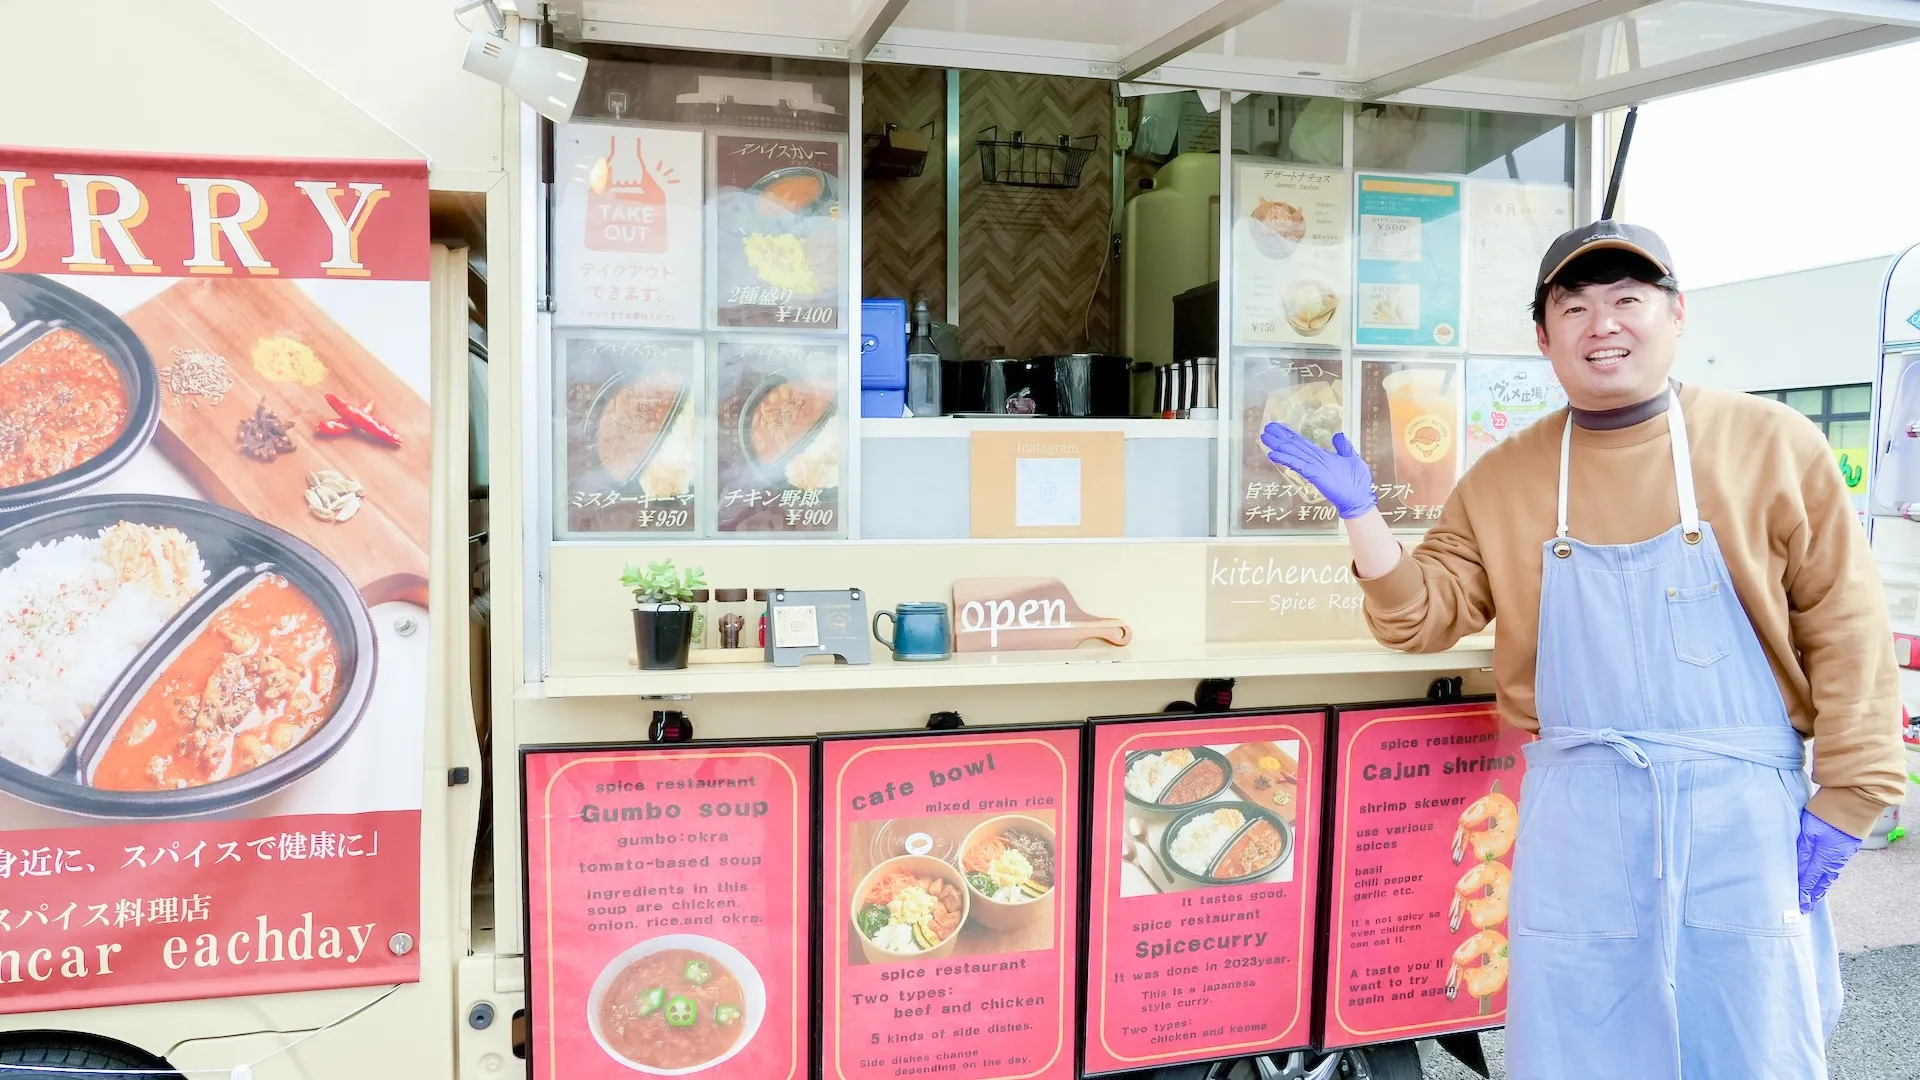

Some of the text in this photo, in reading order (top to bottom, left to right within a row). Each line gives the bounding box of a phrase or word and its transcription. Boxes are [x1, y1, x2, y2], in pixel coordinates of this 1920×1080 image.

[1264, 169, 1331, 184] デザートナチョス
[600, 204, 654, 223] TAKE
[604, 224, 650, 242] OUT
[580, 263, 672, 278] テイクアウト
[588, 284, 666, 302] できます。
[728, 286, 793, 306] 2種盛り
[1494, 379, 1543, 404] グルメ広場
[1017, 442, 1079, 455] Instagram
[571, 490, 694, 509] ミスターキーマ
[724, 488, 822, 508] チキン野郎
[638, 510, 688, 527] ¥950
[786, 509, 834, 526] ¥900
[1245, 504, 1336, 522] チキン ¥700
[1413, 505, 1443, 520] ¥45
[1211, 557, 1355, 585] kitchenca
[1269, 593, 1316, 615] Spice
[961, 596, 1075, 647] open
[1381, 740, 1418, 750] spice
[1363, 755, 1516, 781] Cajun shrimp
[595, 776, 756, 793] spice restaurant
[851, 754, 996, 811] cafe bowl
[580, 800, 768, 822] Gumbo soup
[926, 796, 1054, 813] mixed grain rice
[1360, 796, 1466, 814] shrimp skewer
[617, 832, 729, 847] gumbo:okra
[1356, 823, 1434, 838] use various
[1356, 841, 1397, 852] spices
[579, 856, 761, 873] tomato-based soup
[1355, 866, 1382, 876] basil
[1354, 874, 1423, 888] chili pepper
[587, 882, 748, 900] ingredients in this
[1182, 889, 1287, 907] It tastes good.
[1353, 887, 1415, 901] garlic etc.
[587, 905, 626, 916] soup
[636, 902, 662, 912] are
[1133, 909, 1260, 932] spice restaurant
[1375, 916, 1392, 924] not
[1397, 913, 1424, 922] spicy
[1351, 924, 1421, 937] even children
[163, 913, 376, 970] eachday
[1135, 931, 1268, 959] Spicecurry
[1350, 940, 1368, 949] can
[1374, 938, 1389, 946] eat
[881, 959, 1027, 982] spice restaurant
[1114, 957, 1290, 983] It was done in 2023year.
[1351, 970, 1358, 979] A
[1365, 965, 1400, 976] taste
[1350, 975, 1428, 992] want to try
[853, 986, 954, 1005] Two types:
[1142, 990, 1167, 1000] This
[1173, 988, 1183, 996] is
[1349, 986, 1455, 1006] again and again
[894, 996, 1045, 1018] beef and chicken
[1142, 997, 1213, 1013] style curry.
[871, 1022, 1034, 1045] 5 kinds of side dishes.
[1122, 1020, 1192, 1036] Two types:
[1150, 1032, 1197, 1045] chicken
[1202, 1028, 1224, 1037] and
[860, 1049, 979, 1068] Side dishes change
[894, 1056, 1031, 1076] depending on the day.
